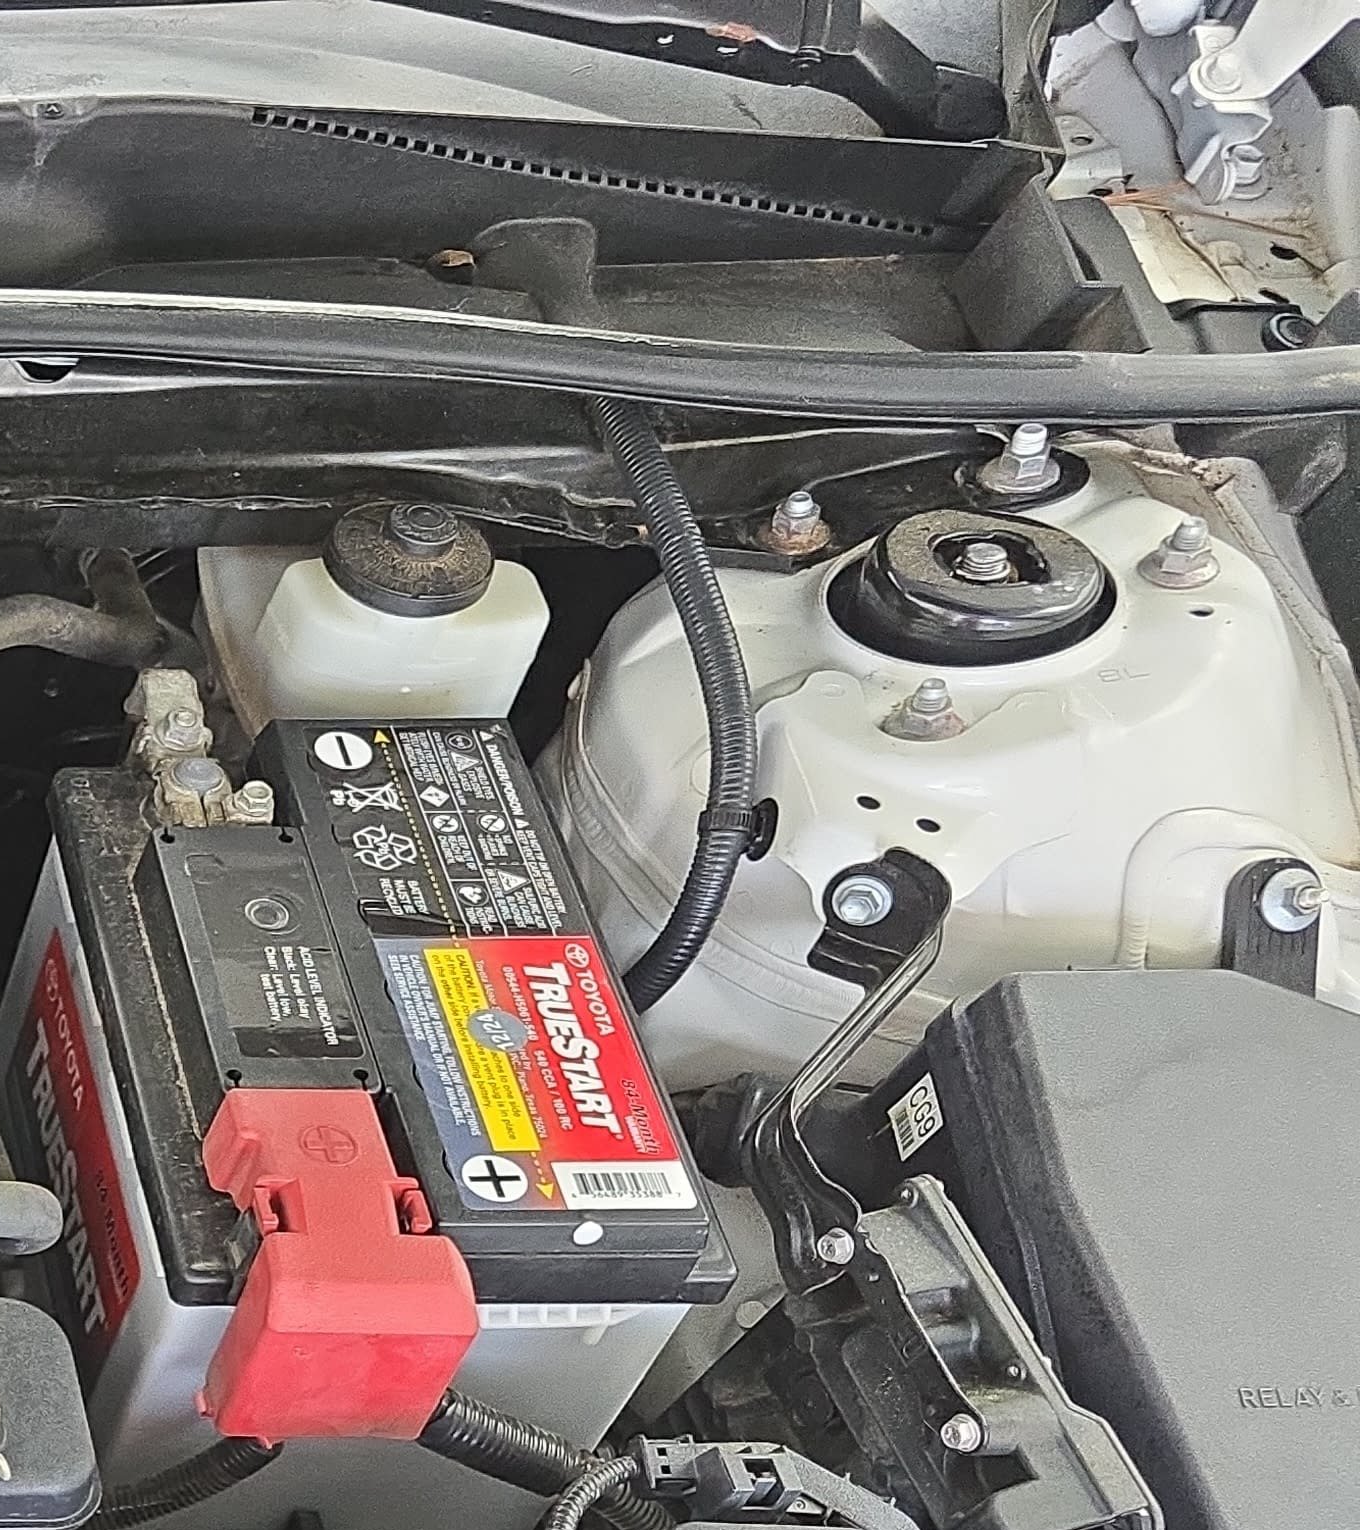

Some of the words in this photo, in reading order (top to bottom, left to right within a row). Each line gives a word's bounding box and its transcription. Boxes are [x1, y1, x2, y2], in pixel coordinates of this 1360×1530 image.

[484, 744, 525, 815] DANGER/POISON
[328, 789, 348, 806] Pb
[377, 877, 404, 915] RECYCLED
[391, 879, 412, 904] MUST
[405, 880, 430, 914] BATTERY
[297, 946, 315, 968] ACID
[386, 954, 402, 971] SEEK
[305, 968, 323, 995] LEVEL
[472, 959, 491, 983] Toyota
[392, 971, 412, 999] SERVICE
[418, 985, 434, 1000] FOR
[439, 979, 455, 999] other
[449, 977, 469, 1004] battery
[423, 1000, 441, 1020] JUMP
[447, 1001, 461, 1016] side
[572, 968, 618, 1036] TOYOTA
[313, 996, 339, 1046] INDICATOR
[400, 963, 420, 990] VEHICLE
[420, 1021, 442, 1053] MANUAL
[437, 1070, 454, 1085] NOT
[453, 1017, 471, 1043] before
[54, 1006, 84, 1111] TOYOTA
[443, 1055, 464, 1084] FOLLOW
[461, 1043, 483, 1078] installing
[501, 1084, 515, 1099] one
[539, 1068, 558, 1088] CCA
[557, 1116, 574, 1130] RC
[453, 1084, 482, 1136] INSTRUCTIONS
[486, 1081, 504, 1099] plug
[500, 1118, 519, 1140] place
[507, 1101, 523, 1117] side
[619, 1079, 663, 1154] 84-Month
[910, 1086, 936, 1137] CG9
[1238, 1386, 1323, 1409] RELAY
